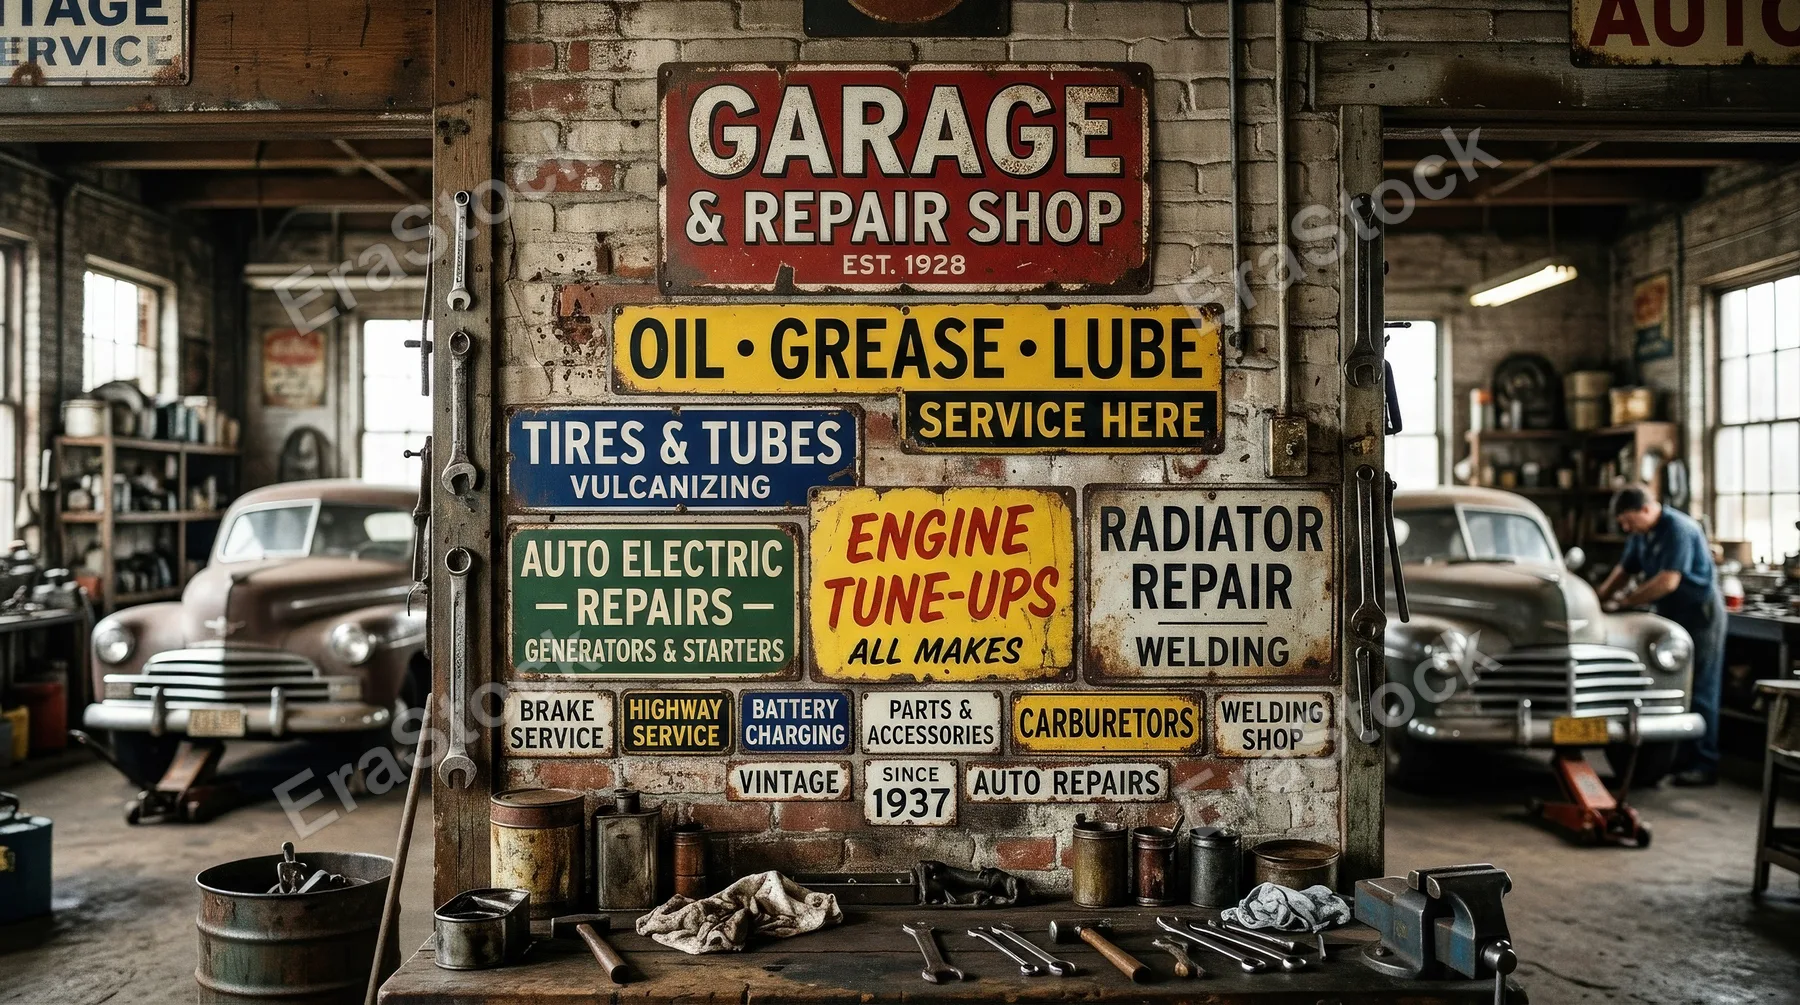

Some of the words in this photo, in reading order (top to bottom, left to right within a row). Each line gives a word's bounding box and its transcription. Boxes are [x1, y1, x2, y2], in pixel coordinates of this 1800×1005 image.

[0, 0, 168, 26] AGE
[687, 84, 1124, 179] GARAGE
[685, 190, 726, 246] &
[744, 190, 950, 246] REPAIR
[967, 190, 1125, 246] SHOP
[843, 254, 896, 276] EST.
[904, 254, 967, 276] 1928
[629, 317, 725, 380] OIL
[770, 317, 1004, 380] GREASE
[1054, 317, 1204, 380] LUBE
[918, 401, 1086, 440] SERVICE
[1101, 401, 1205, 440] HERE
[522, 420, 646, 466] TIRES
[659, 420, 689, 466] &
[702, 420, 843, 466] TUBES
[570, 475, 771, 501] VULCANIZING
[846, 503, 1034, 564] ENGINE
[1100, 505, 1325, 553] RADIATOR
[521, 540, 610, 579] AUTO
[622, 540, 783, 579] ELECTRIC
[824, 565, 1060, 628] TUNE-UPS
[1132, 562, 1292, 611] REPAIR
[577, 588, 733, 627] REPAIRS
[524, 638, 656, 664] GENERATORS
[661, 638, 677, 663] &
[683, 638, 785, 663] STARTERS
[847, 637, 902, 666] ALL
[912, 636, 1024, 666] MAKES
[1136, 636, 1290, 667] WELDING
[519, 699, 595, 722] BRAKE
[629, 698, 722, 720] HIGHWAY
[752, 697, 838, 720] BATTERY
[889, 698, 952, 722] PARTS
[958, 698, 973, 722] &
[1221, 701, 1324, 724] WELDING
[745, 723, 845, 746] CHARGING
[867, 724, 994, 746] ACCESSORIES
[1019, 706, 1194, 739] CARBURETORS
[510, 727, 604, 750] SERVICE
[632, 725, 719, 748] SERVICE
[1242, 728, 1304, 751] SHOP
[739, 769, 841, 796] VINTAGE
[882, 766, 940, 783] SINCE
[974, 769, 1043, 796] AUTO
[1053, 769, 1161, 796] REPAIRS
[872, 787, 951, 818] 1937
